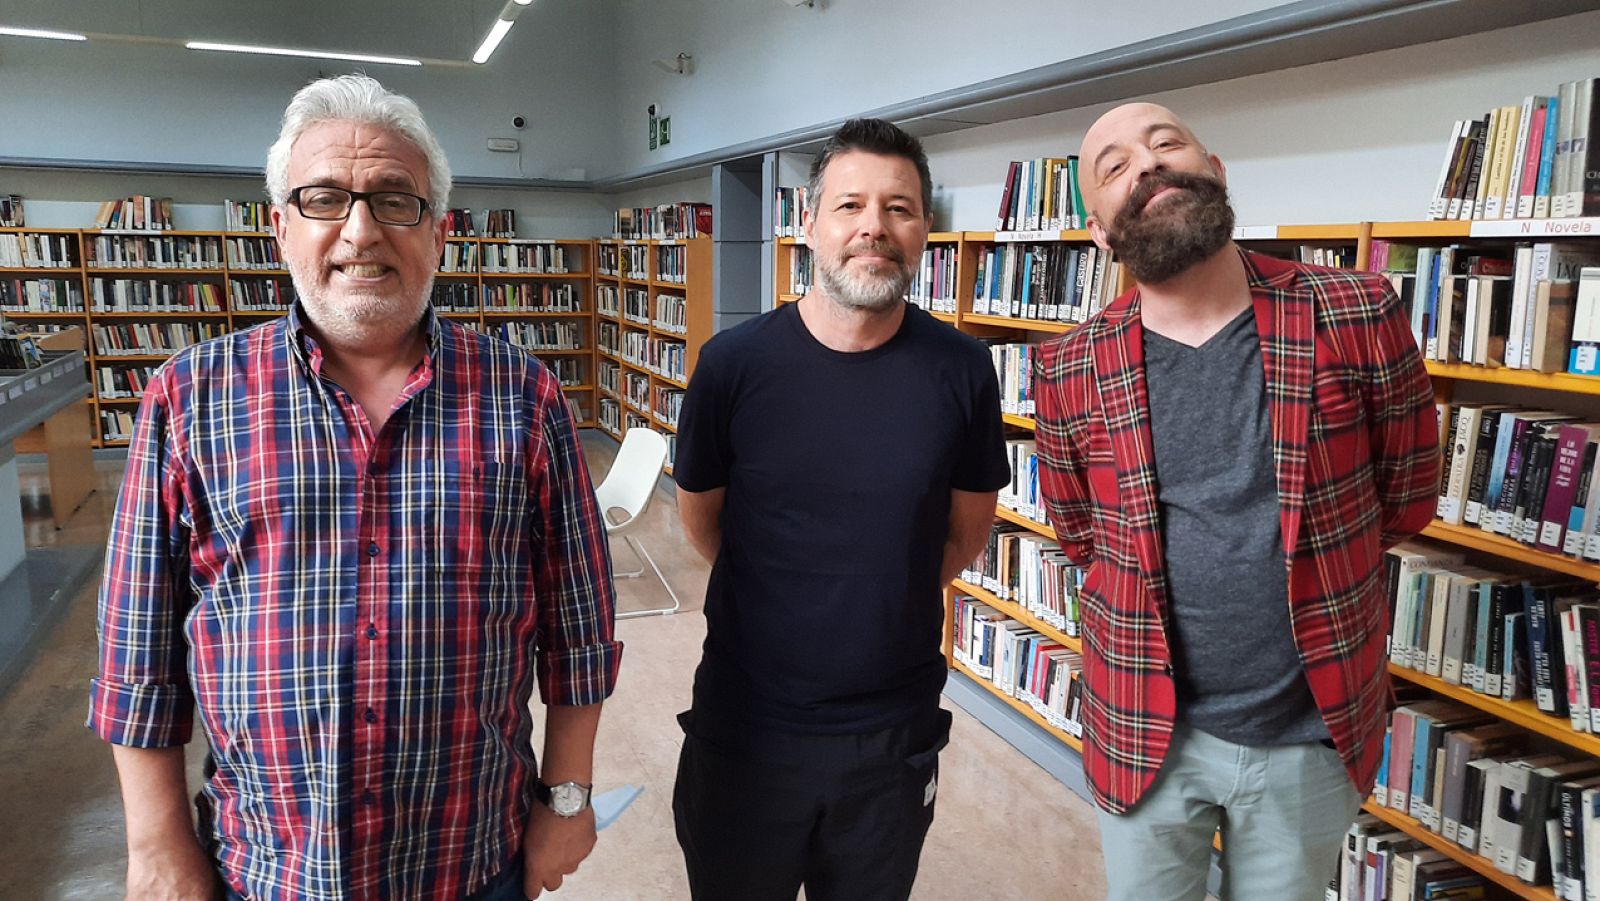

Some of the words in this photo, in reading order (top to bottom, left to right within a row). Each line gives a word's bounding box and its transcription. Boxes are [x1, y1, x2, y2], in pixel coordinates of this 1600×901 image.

[1521, 222, 1531, 233] N
[1545, 221, 1592, 233] Novela
[1459, 416, 1472, 441] JACQ
